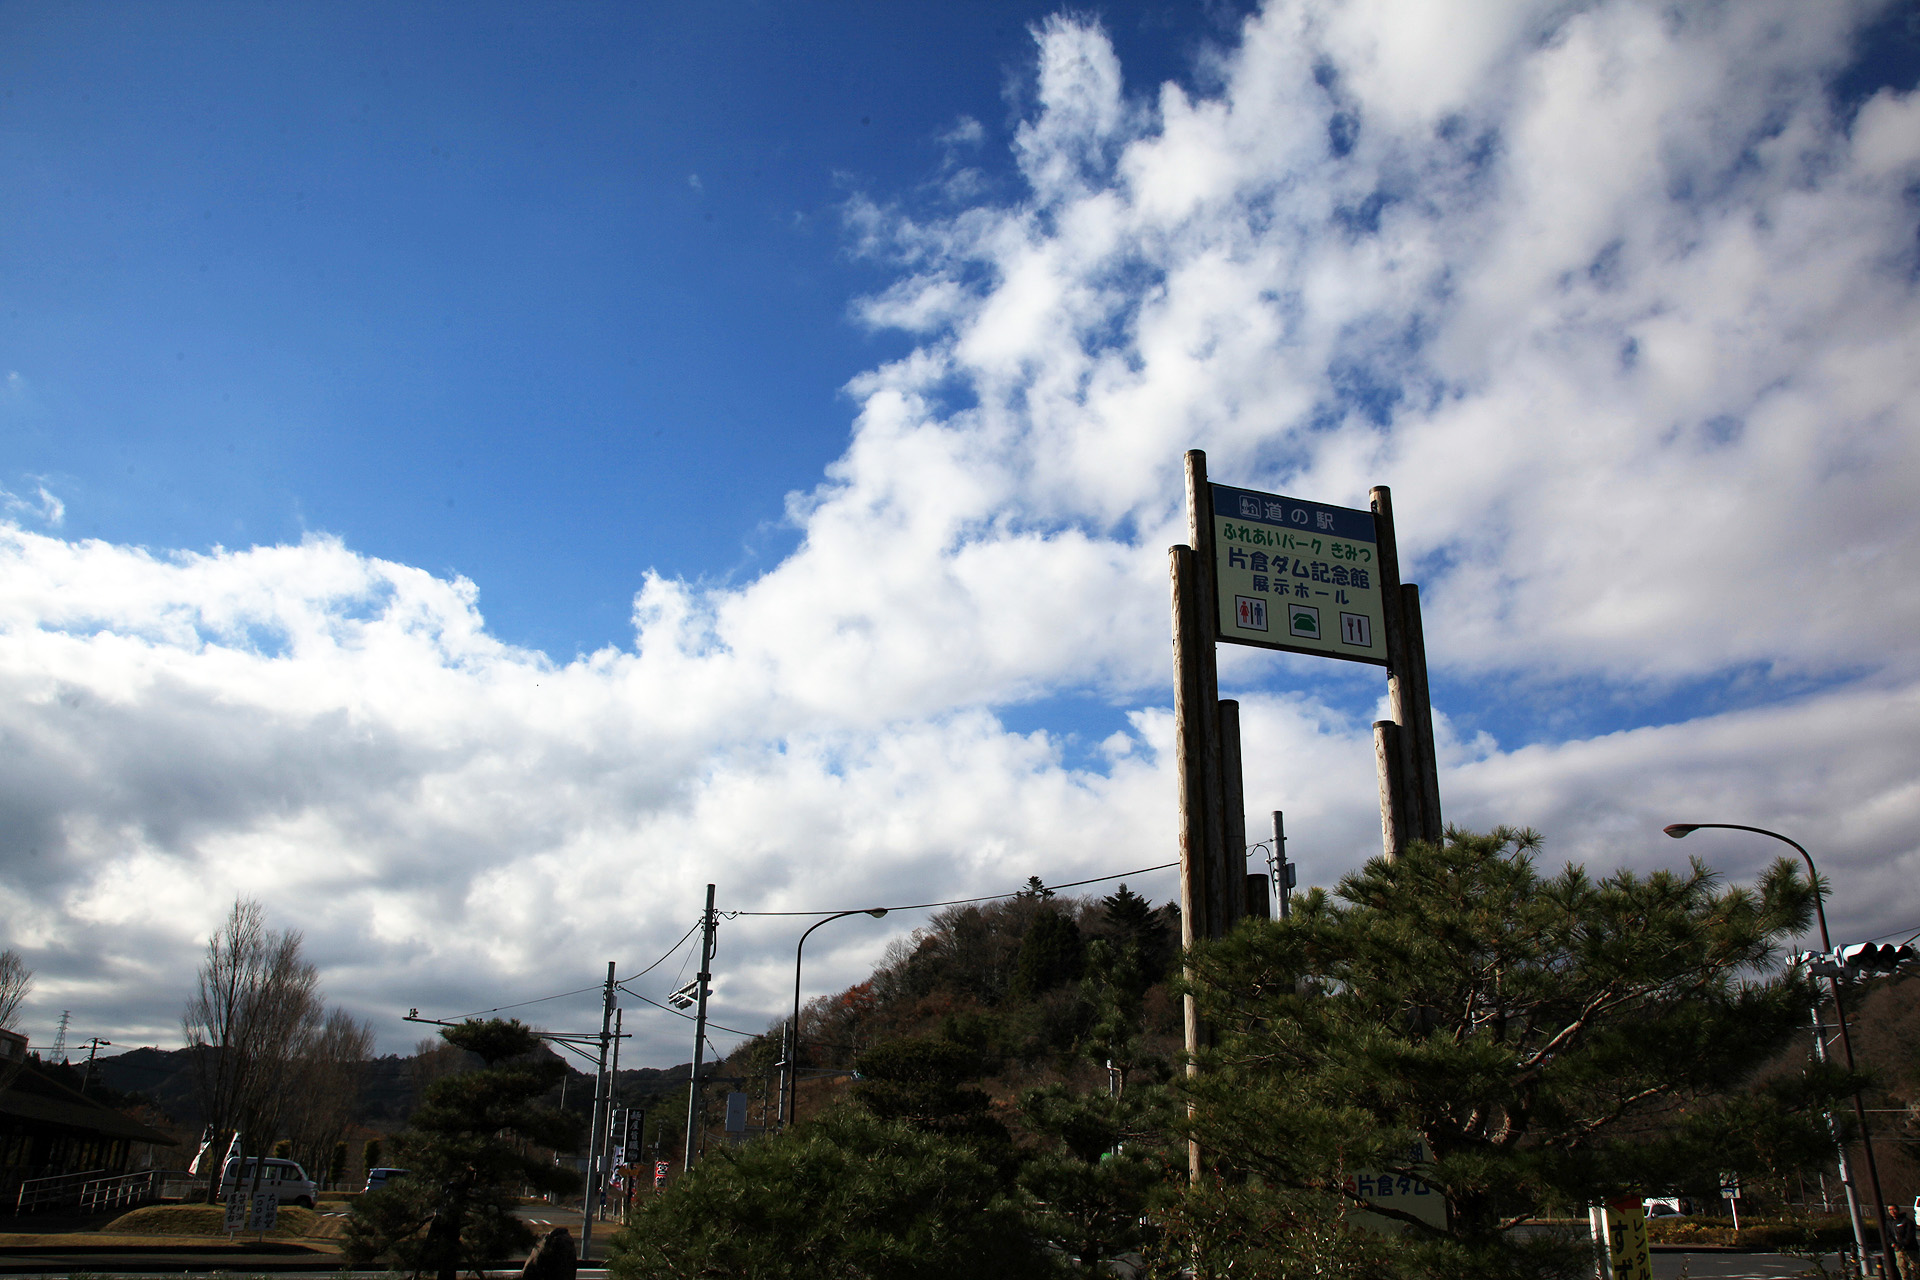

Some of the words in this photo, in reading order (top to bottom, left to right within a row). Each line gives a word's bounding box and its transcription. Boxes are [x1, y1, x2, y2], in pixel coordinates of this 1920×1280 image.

[1265, 501, 1335, 531] 道の駅
[1223, 522, 1322, 555] ふれあいパーク
[1331, 542, 1372, 563] きみつ
[1228, 546, 1370, 590] 片倉ダム記念館
[1252, 574, 1350, 605] 展示ホール
[1358, 1173, 1431, 1197] 片倉ダム
[1633, 1219, 1651, 1280] レンタル
